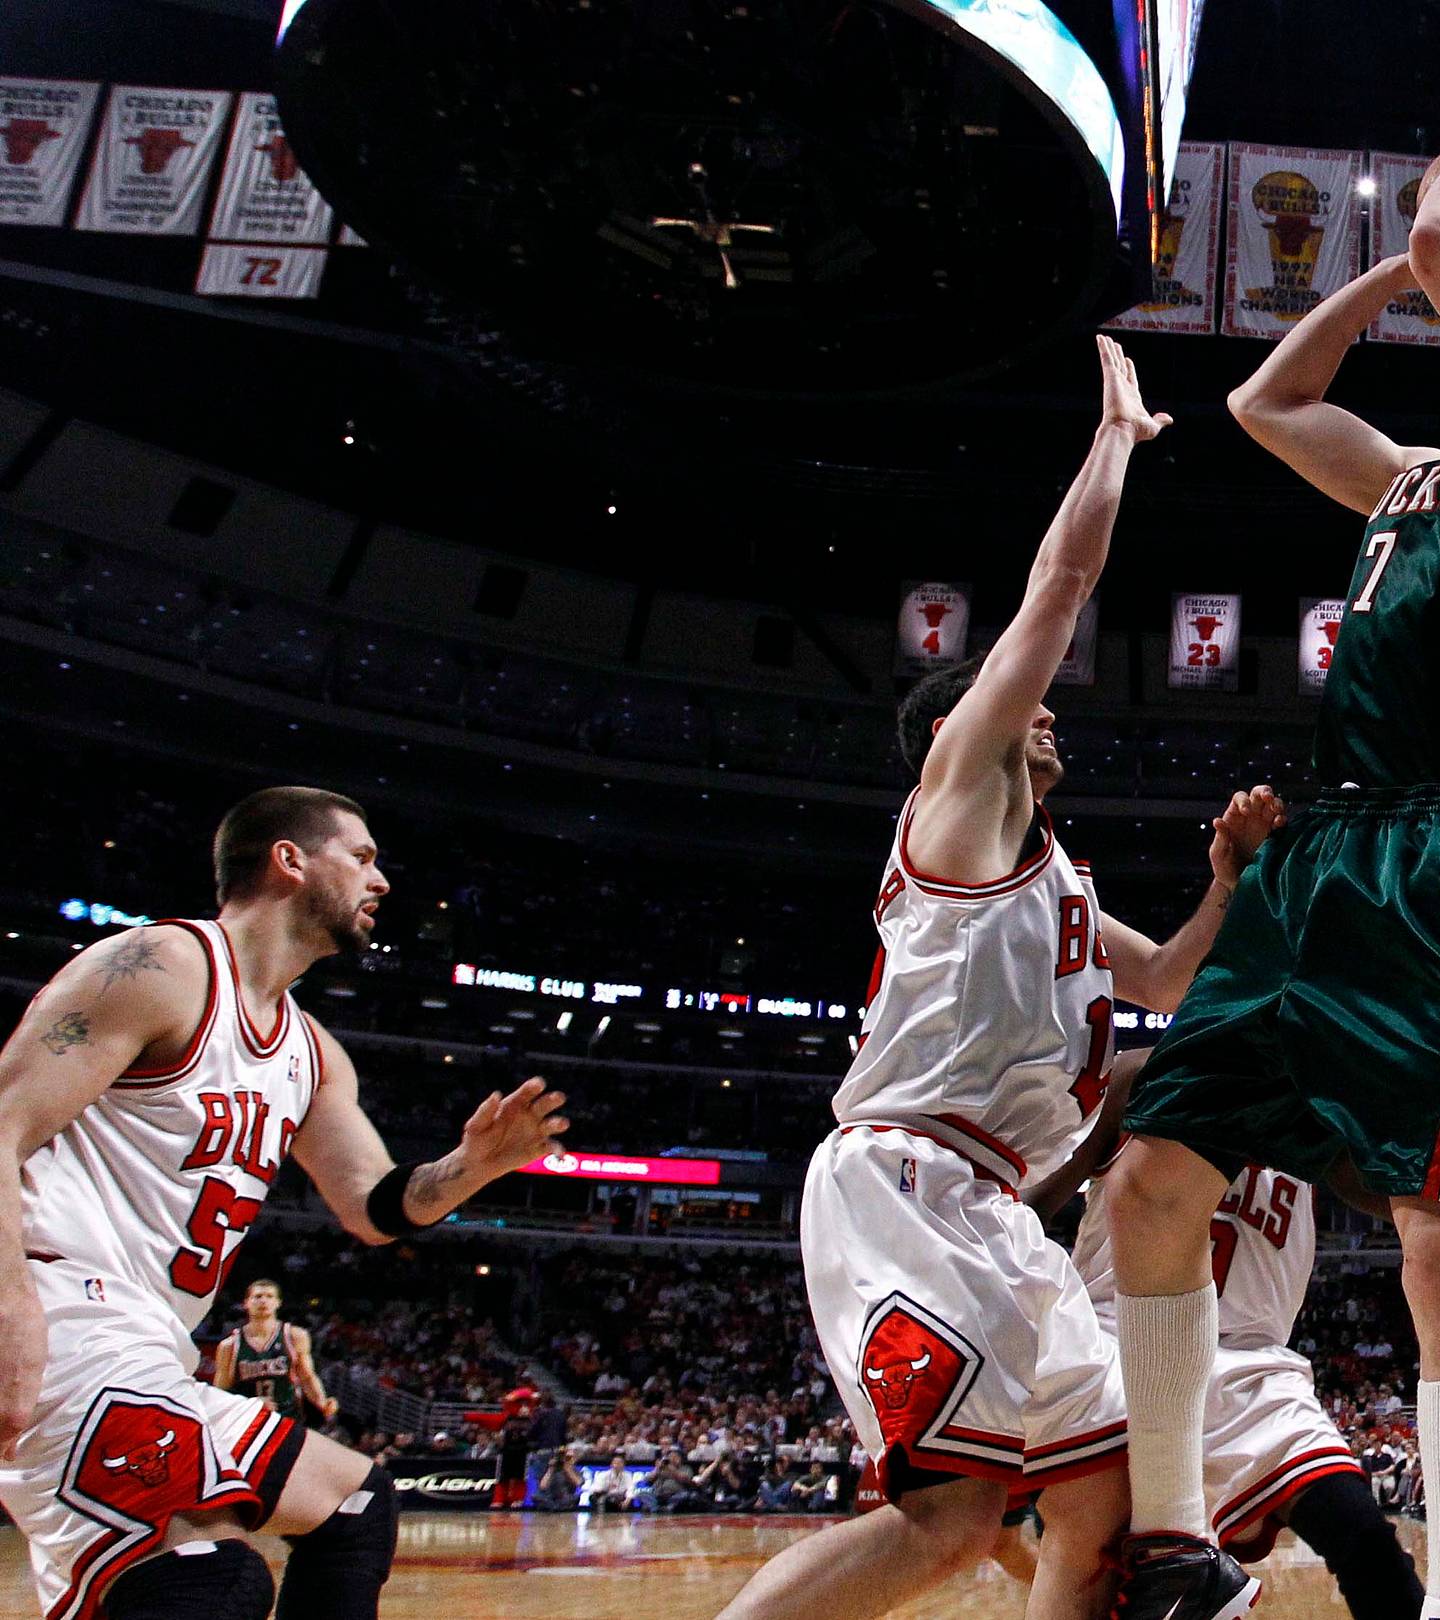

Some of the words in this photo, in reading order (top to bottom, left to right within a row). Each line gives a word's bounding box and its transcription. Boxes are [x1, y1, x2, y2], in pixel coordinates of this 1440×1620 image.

[242, 256, 282, 286] 72
[1351, 530, 1399, 615] 7
[1185, 599, 1228, 608] CHICAGO
[1192, 607, 1222, 616] BULLS
[1319, 612, 1342, 621] BULL
[922, 630, 940, 656] 4
[1187, 643, 1221, 667] 23
[540, 978, 585, 999] CLUB
[857, 1489, 881, 1501] KIA
